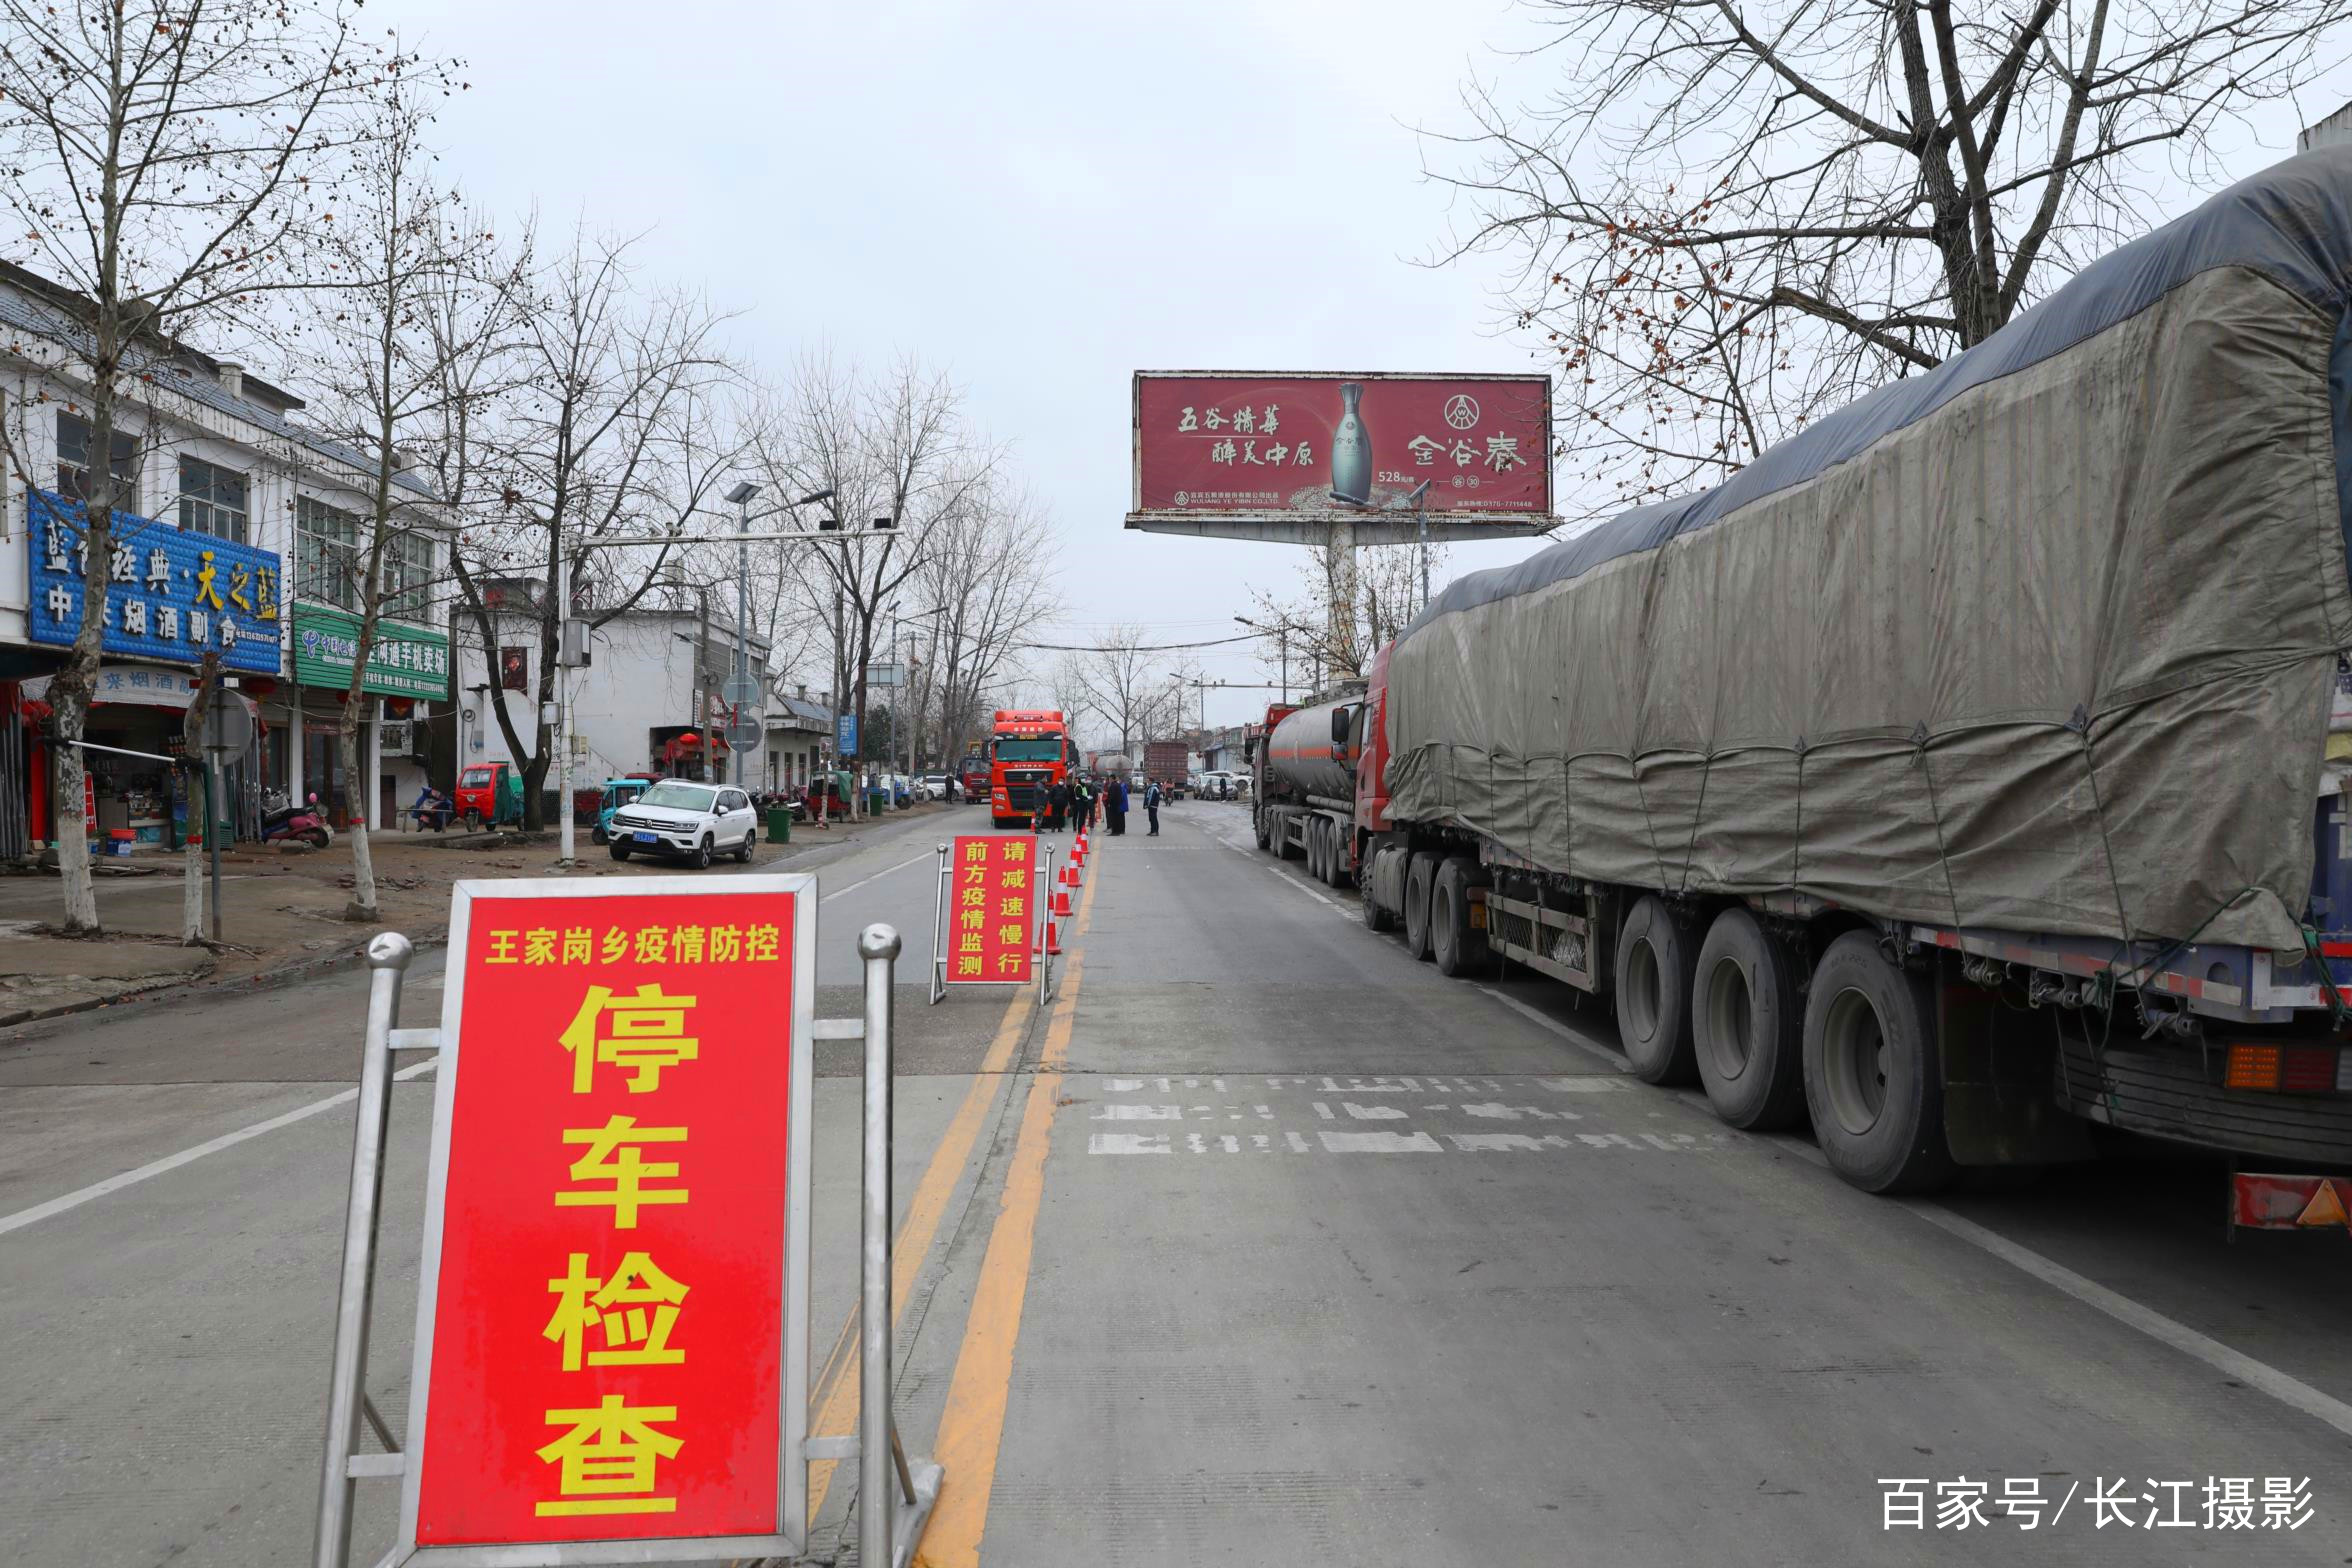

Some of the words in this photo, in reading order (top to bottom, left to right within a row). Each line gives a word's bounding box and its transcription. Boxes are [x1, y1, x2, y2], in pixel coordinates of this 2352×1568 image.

[1212, 438, 1313, 467] 醉美中原
[1408, 431, 1527, 473] 金谷春
[485, 923, 779, 966] 王家岗乡疫情防控
[958, 841, 989, 976] 前方疫情监测
[997, 841, 1027, 974] 请减速慢行
[534, 982, 700, 1518] 停车检查
